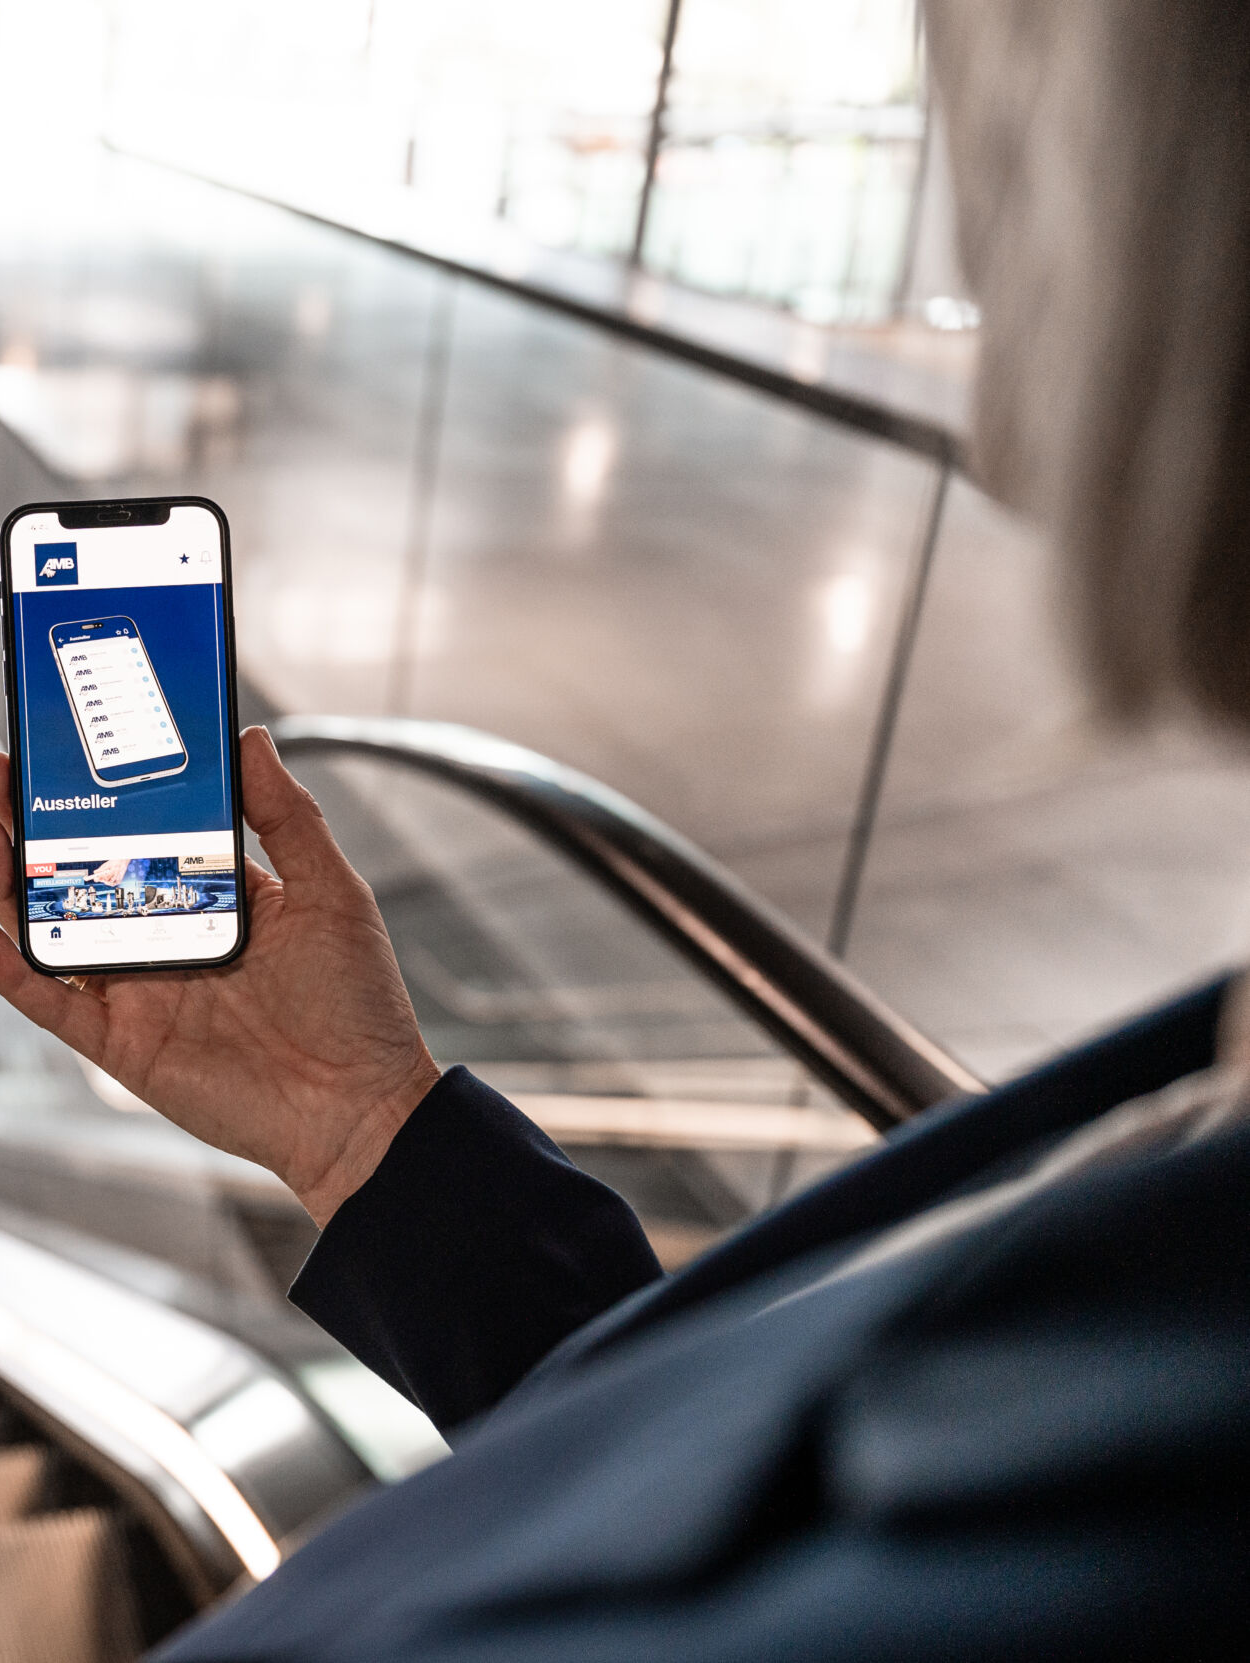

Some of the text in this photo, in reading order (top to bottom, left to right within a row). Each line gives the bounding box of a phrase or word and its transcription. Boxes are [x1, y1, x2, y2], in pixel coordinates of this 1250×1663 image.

[39, 557, 75, 577] AMB
[71, 654, 88, 662] AMB
[76, 669, 93, 677] AMB
[81, 684, 98, 692] AMB
[86, 700, 103, 708] AMB
[91, 715, 108, 723] AMB
[97, 731, 114, 739] AMB
[102, 748, 120, 756] AMB
[32, 794, 118, 812] Aussteller
[184, 857, 205, 865] AMB
[34, 865, 53, 873] YOU
